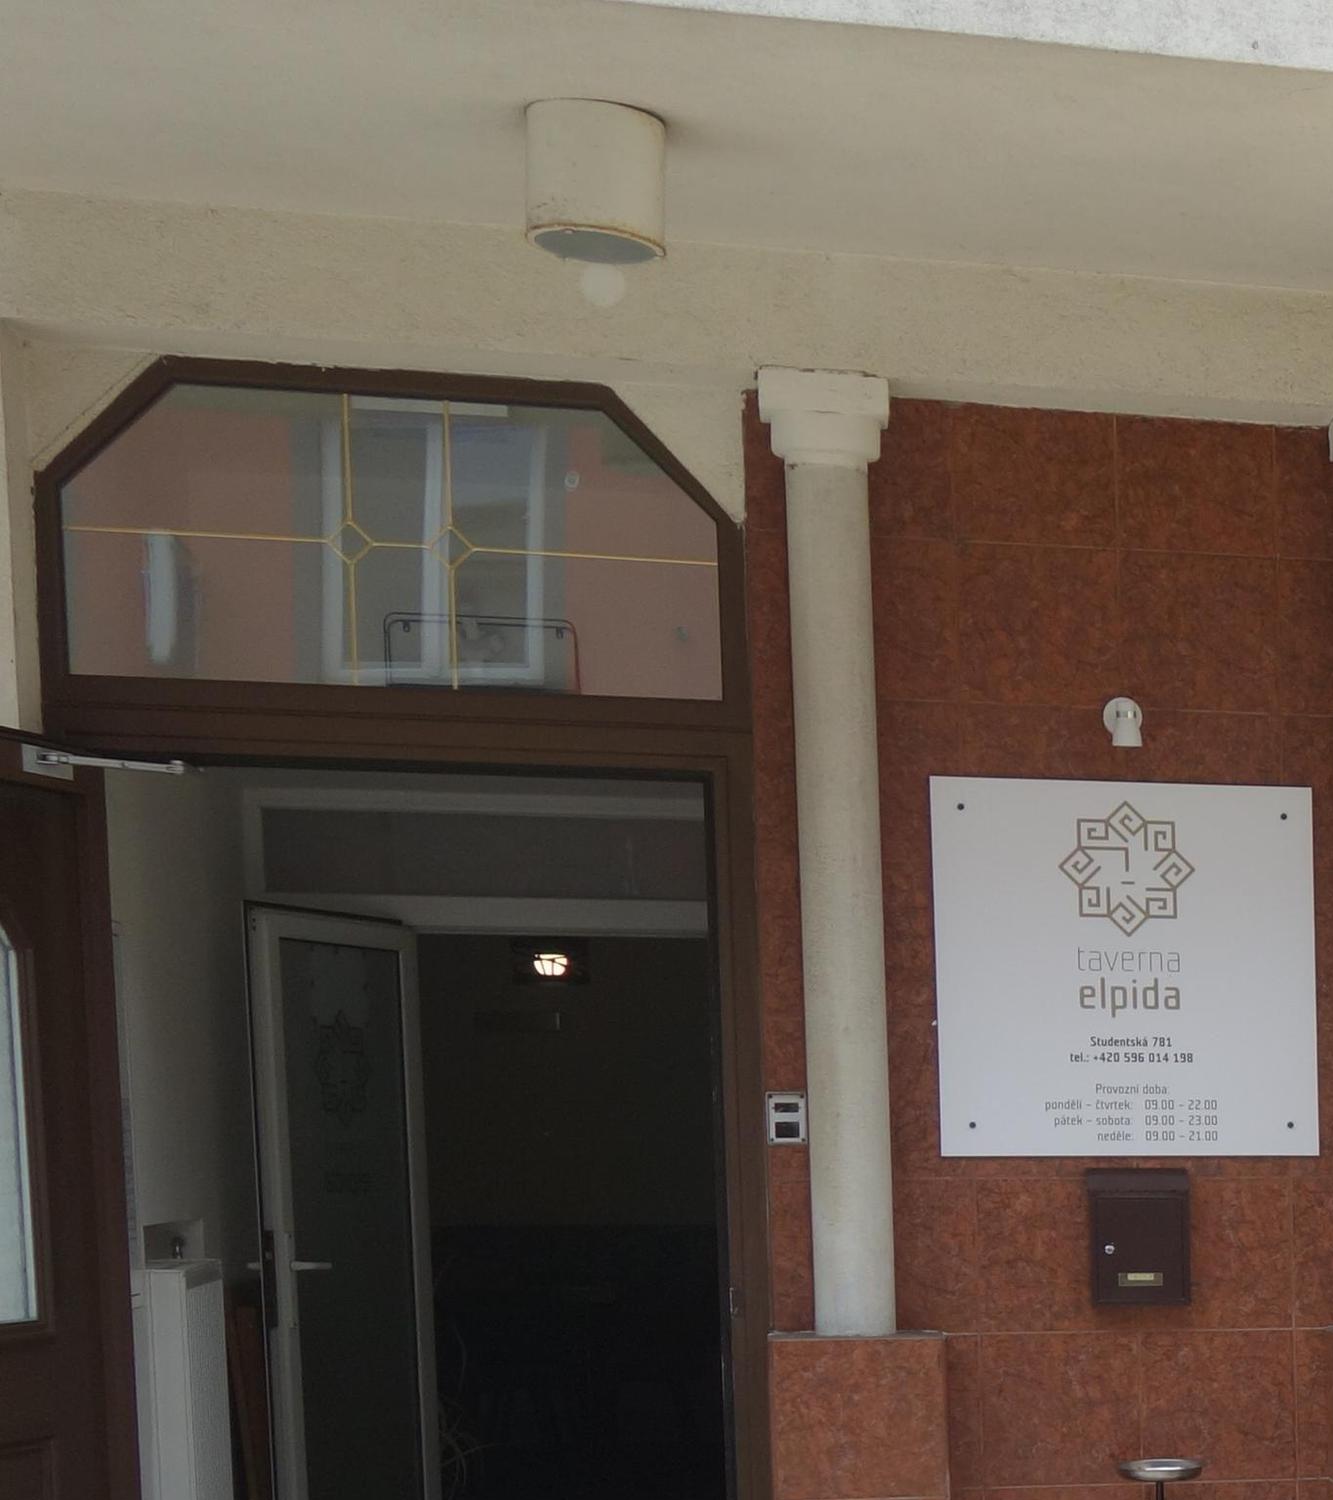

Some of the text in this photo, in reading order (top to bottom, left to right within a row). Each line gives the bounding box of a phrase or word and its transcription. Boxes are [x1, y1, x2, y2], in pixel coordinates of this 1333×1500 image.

[1077, 946, 1181, 973] taverna
[1079, 978, 1181, 1018] elpida
[1090, 1036, 1172, 1048] Studentská 781
[1070, 1052, 1193, 1063] tel.: +420 596 014 198
[1095, 1083, 1139, 1095] Provozní
[1144, 1100, 1174, 1110] 09.00
[1188, 1100, 1217, 1110] 22.00
[1054, 1115, 1083, 1127] pátek
[1144, 1115, 1175, 1126] 09.00
[1188, 1115, 1218, 1126] 23.00
[1145, 1131, 1175, 1141] 09.00
[1188, 1131, 1218, 1141] 21.00
